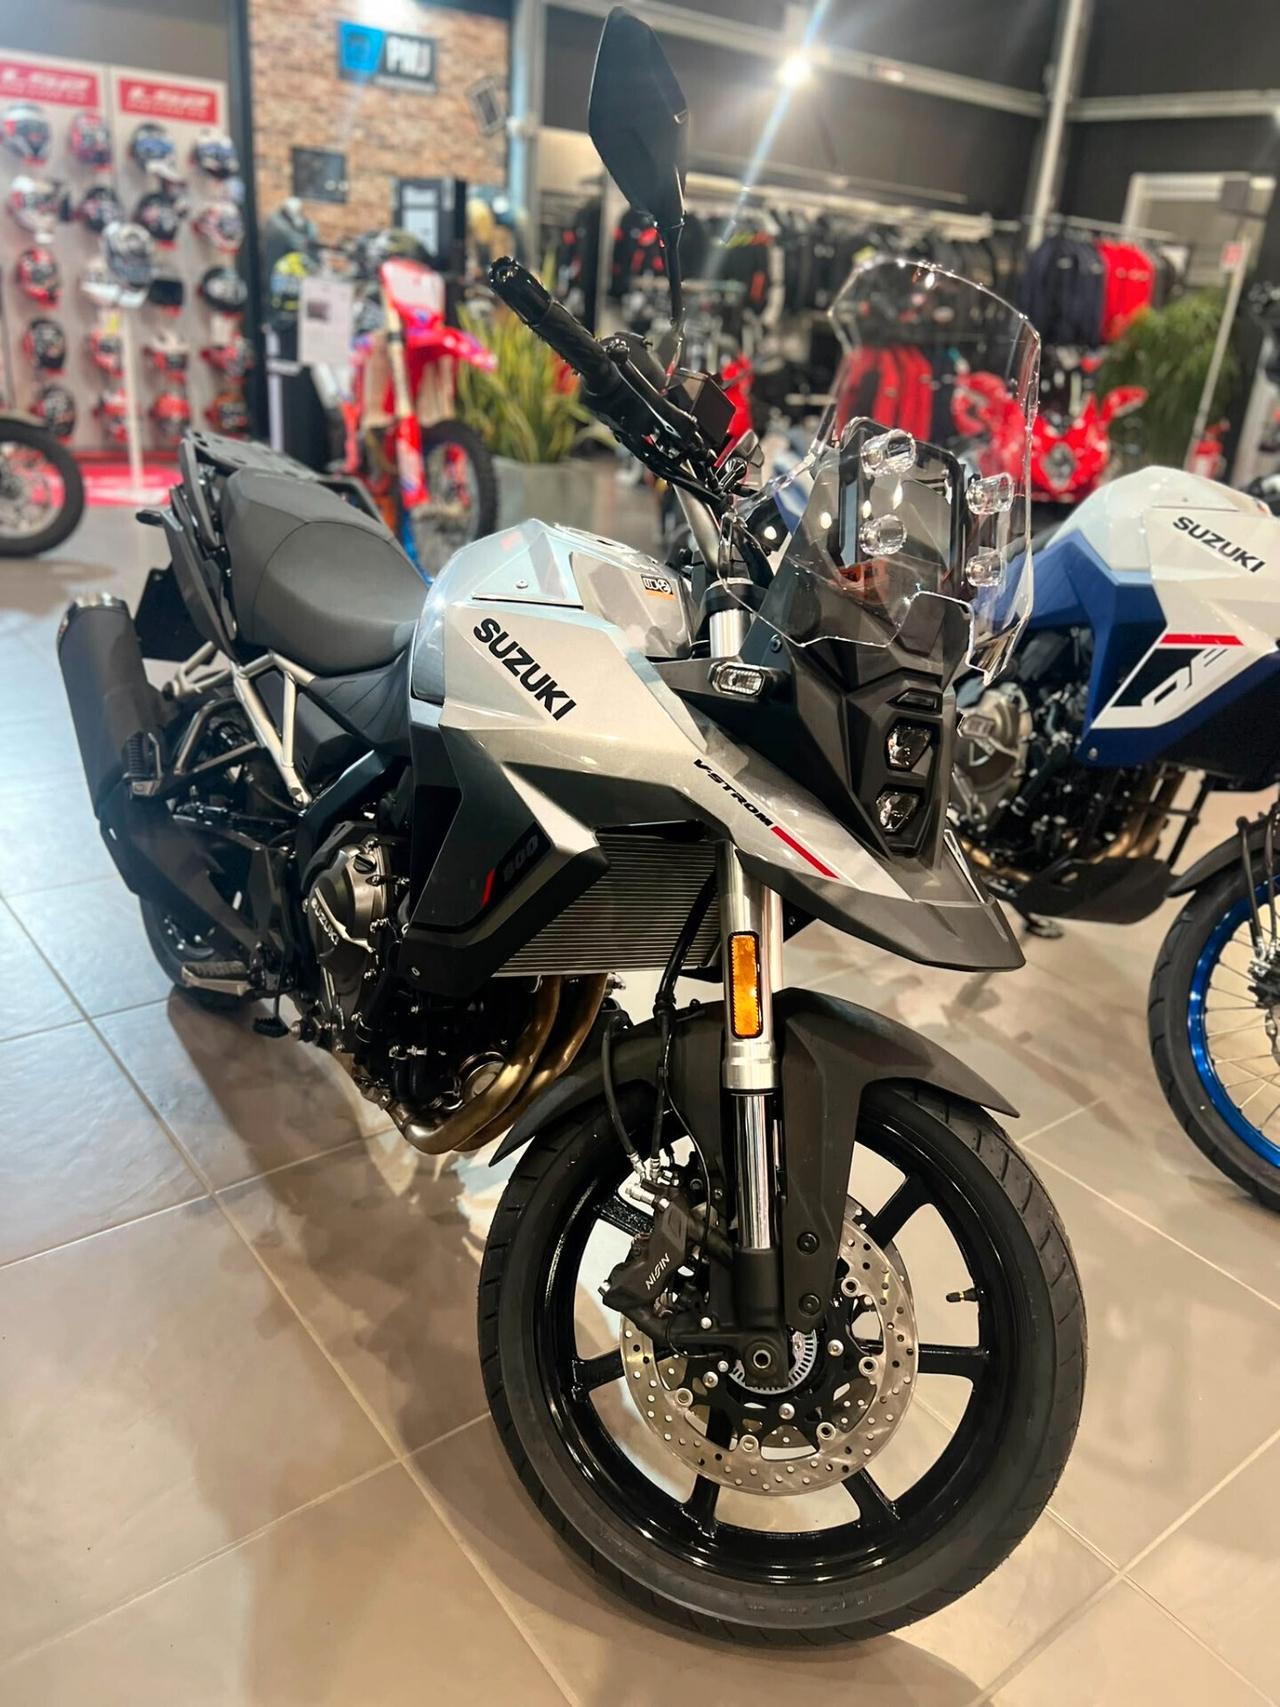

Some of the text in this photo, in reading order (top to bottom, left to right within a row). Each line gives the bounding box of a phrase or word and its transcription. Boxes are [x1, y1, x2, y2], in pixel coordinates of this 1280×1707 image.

[1172, 516, 1266, 573] SUZUKI
[473, 617, 577, 721] SUZUKI
[694, 758, 774, 827] V-STROM
[311, 897, 340, 946] SUZUKI
